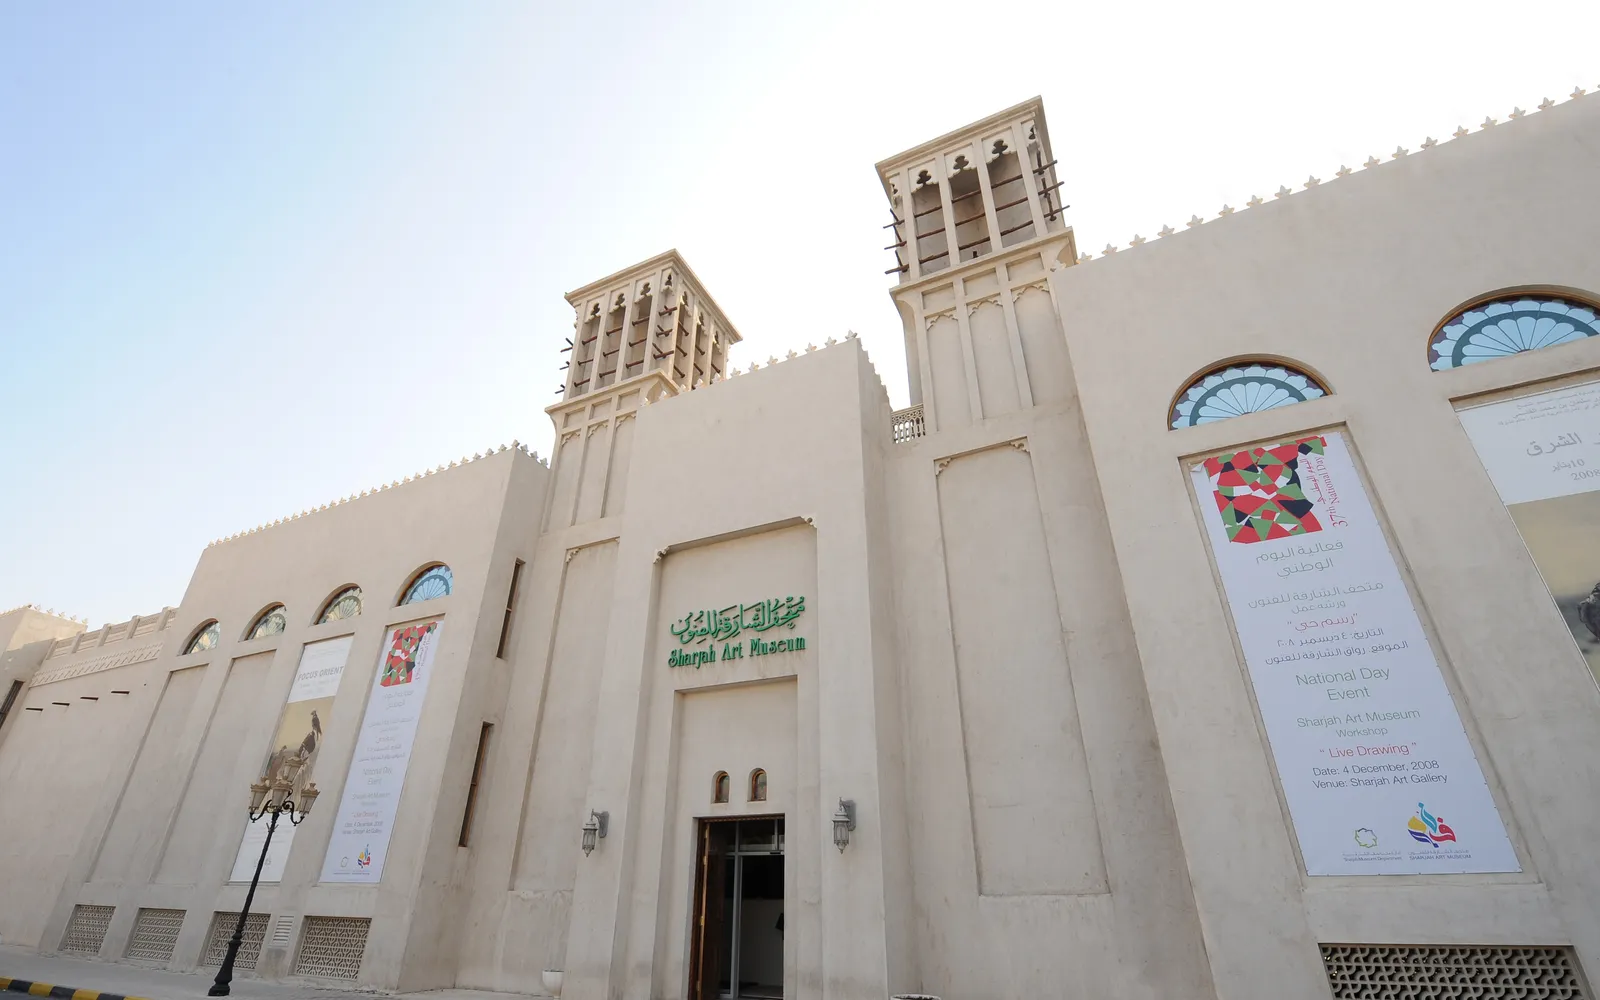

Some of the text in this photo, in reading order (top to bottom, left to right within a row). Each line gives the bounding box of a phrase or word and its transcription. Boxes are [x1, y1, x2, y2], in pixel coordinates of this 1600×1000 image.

[1526, 431, 1583, 457] الشرق
[1315, 455, 1327, 472] Day
[1319, 472, 1340, 505] National
[1256, 540, 1344, 565] فعالية اليوم
[1276, 556, 1334, 580] الوطني
[1248, 581, 1384, 609] متحف الشارقة للفنون
[1291, 604, 1316, 615] عمل
[1299, 634, 1341, 647] ديسمبر
[667, 637, 806, 670] Sharjah Art Museum
[1302, 648, 1342, 660] الشارقة
[1344, 646, 1366, 657] رواق
[1295, 667, 1390, 686] National Day
[1327, 686, 1371, 701] Event
[1297, 709, 1421, 728] Sharjah Art Museum
[1336, 727, 1389, 738] Workshop
[1328, 747, 1354, 758] Live
[1356, 744, 1410, 756] Drawing
[1312, 760, 1440, 776] Date: 4 December, 2008
[1312, 773, 1448, 789] Venue: Sharjah Art Gallery
